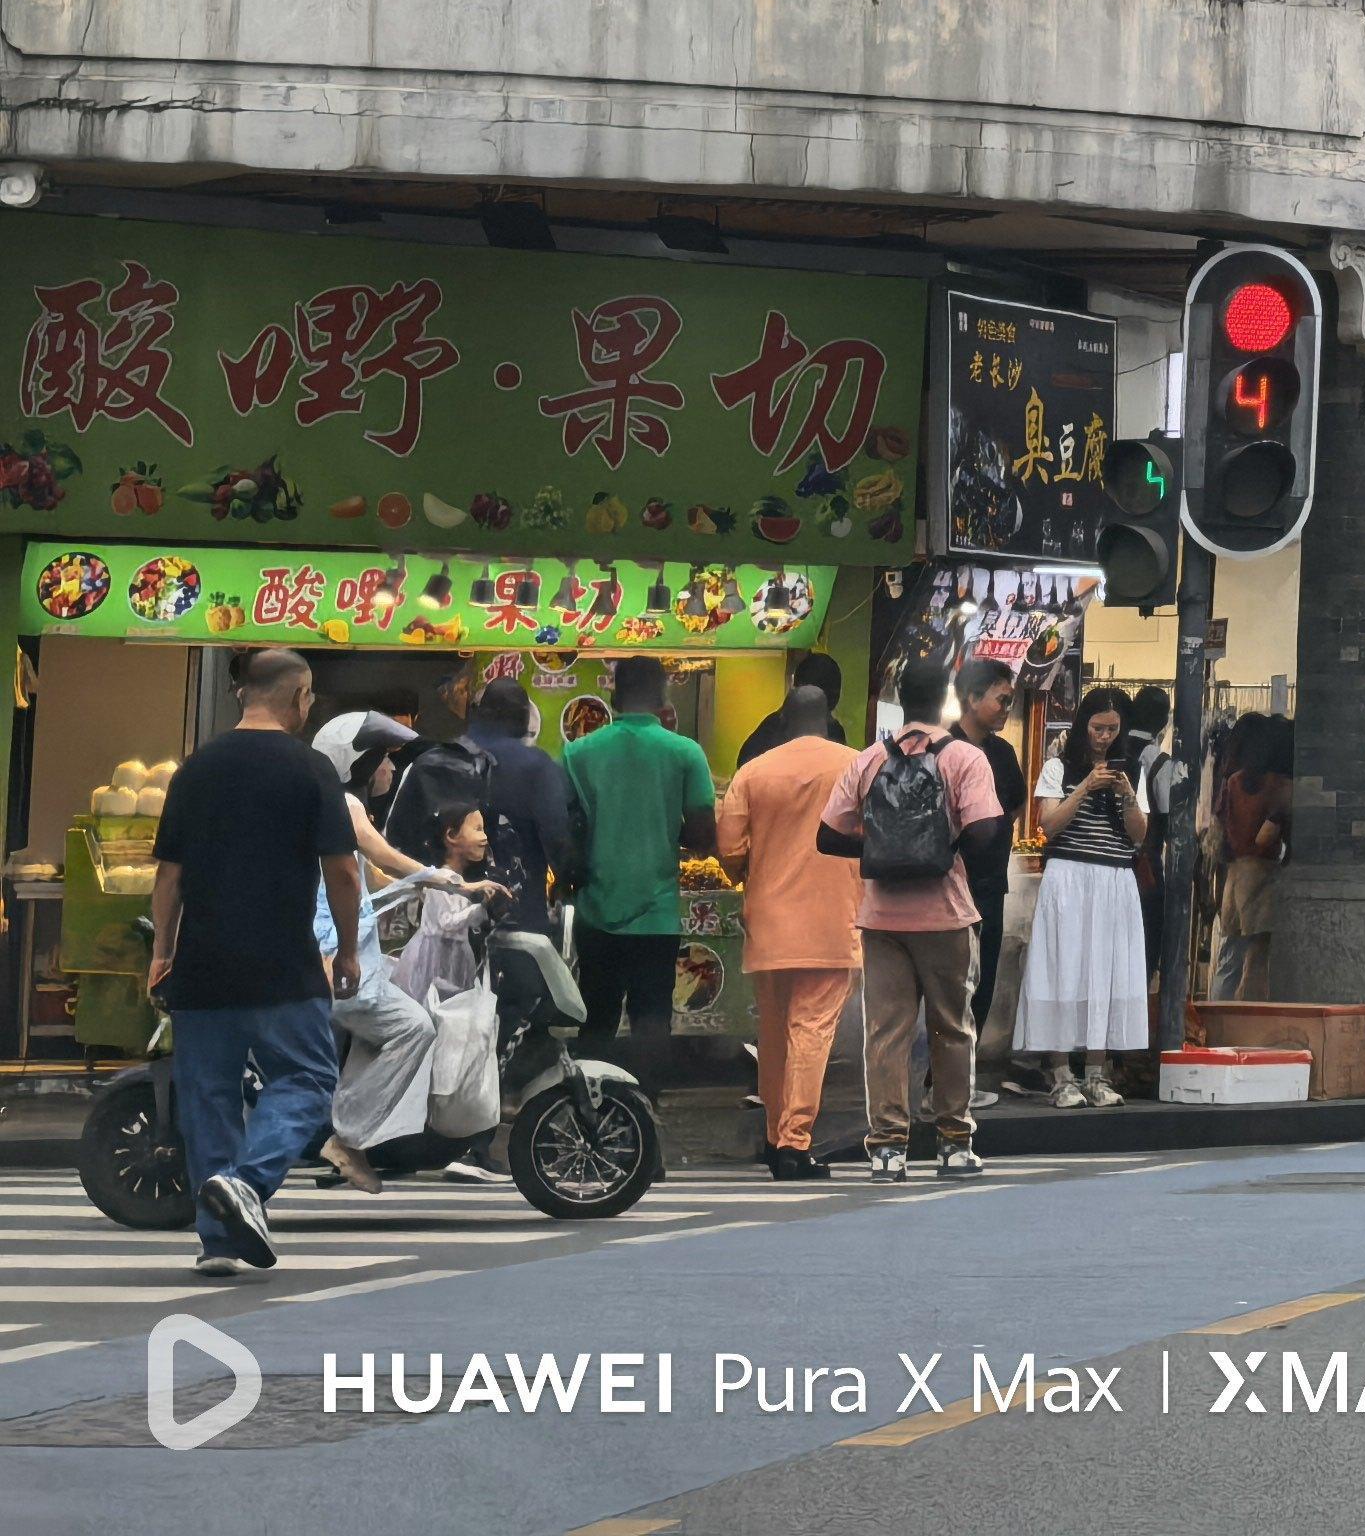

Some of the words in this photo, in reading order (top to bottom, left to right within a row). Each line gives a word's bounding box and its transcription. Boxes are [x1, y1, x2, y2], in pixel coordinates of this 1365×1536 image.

[1012, 386, 1107, 492] 臭豆腐
[1235, 374, 1267, 429] 4
